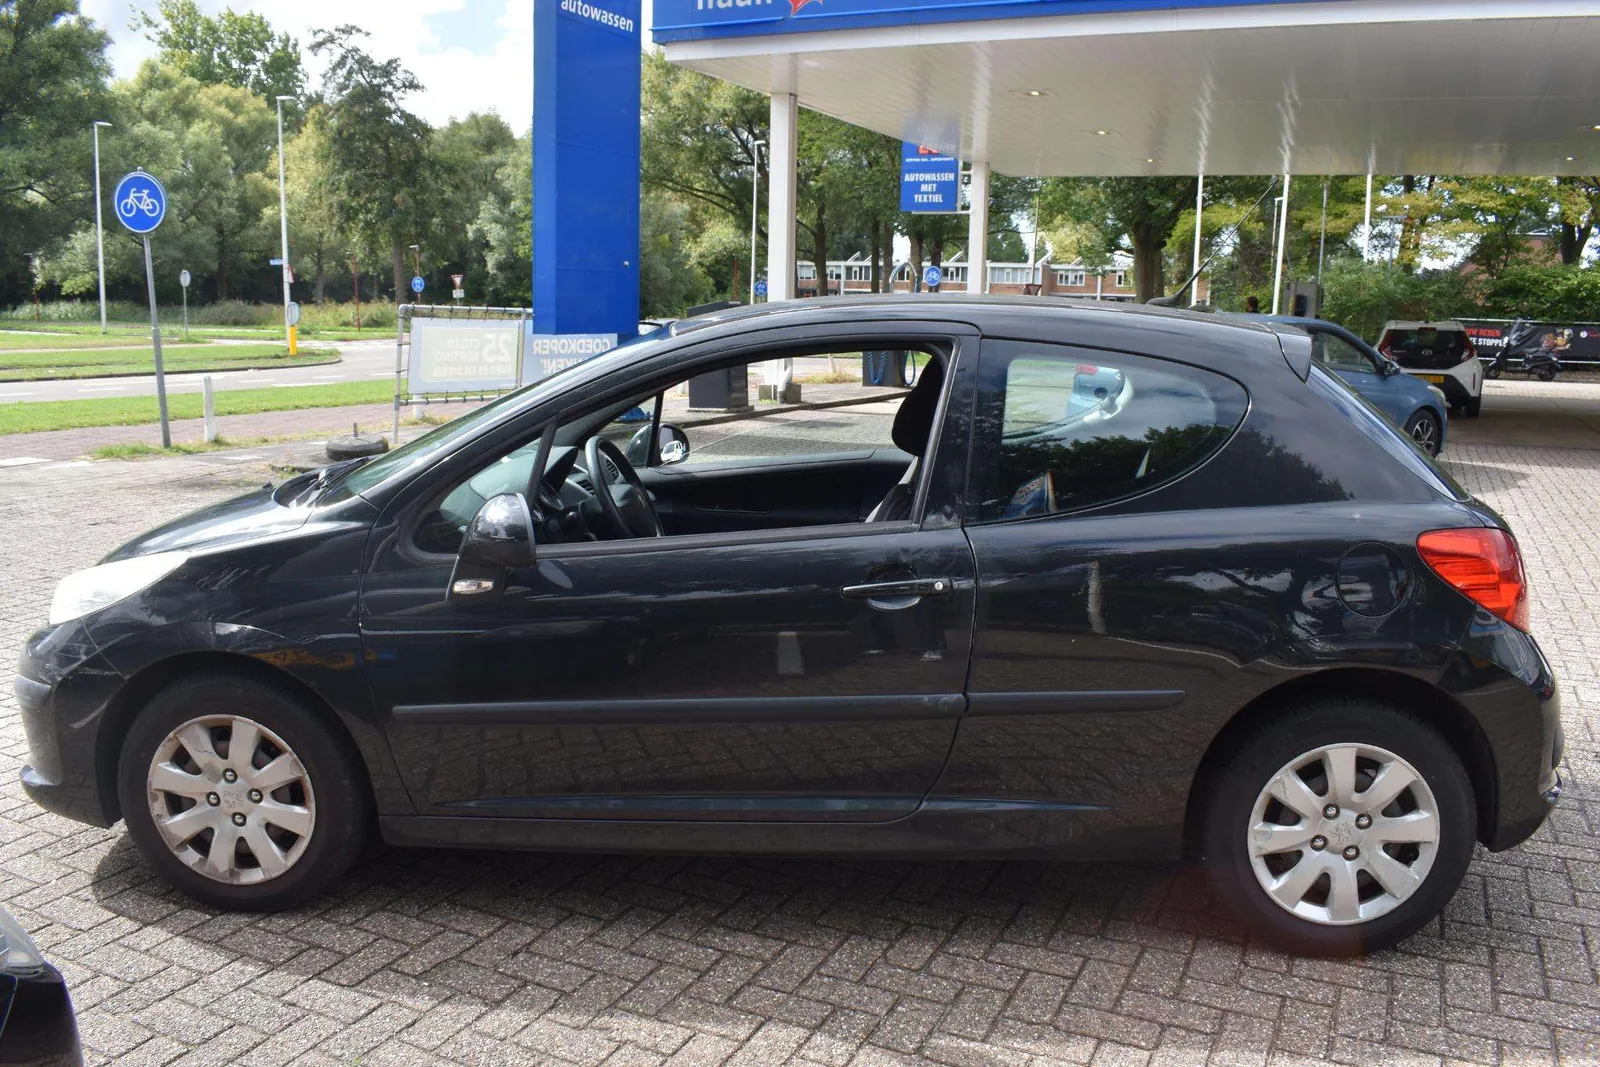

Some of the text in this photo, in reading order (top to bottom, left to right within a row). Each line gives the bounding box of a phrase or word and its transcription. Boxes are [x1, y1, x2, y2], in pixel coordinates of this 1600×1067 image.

[560, 0, 634, 32] autowassen
[904, 172, 955, 182] AUTOWASSEN
[920, 183, 937, 192] MET
[914, 194, 944, 203] TEXTIEL
